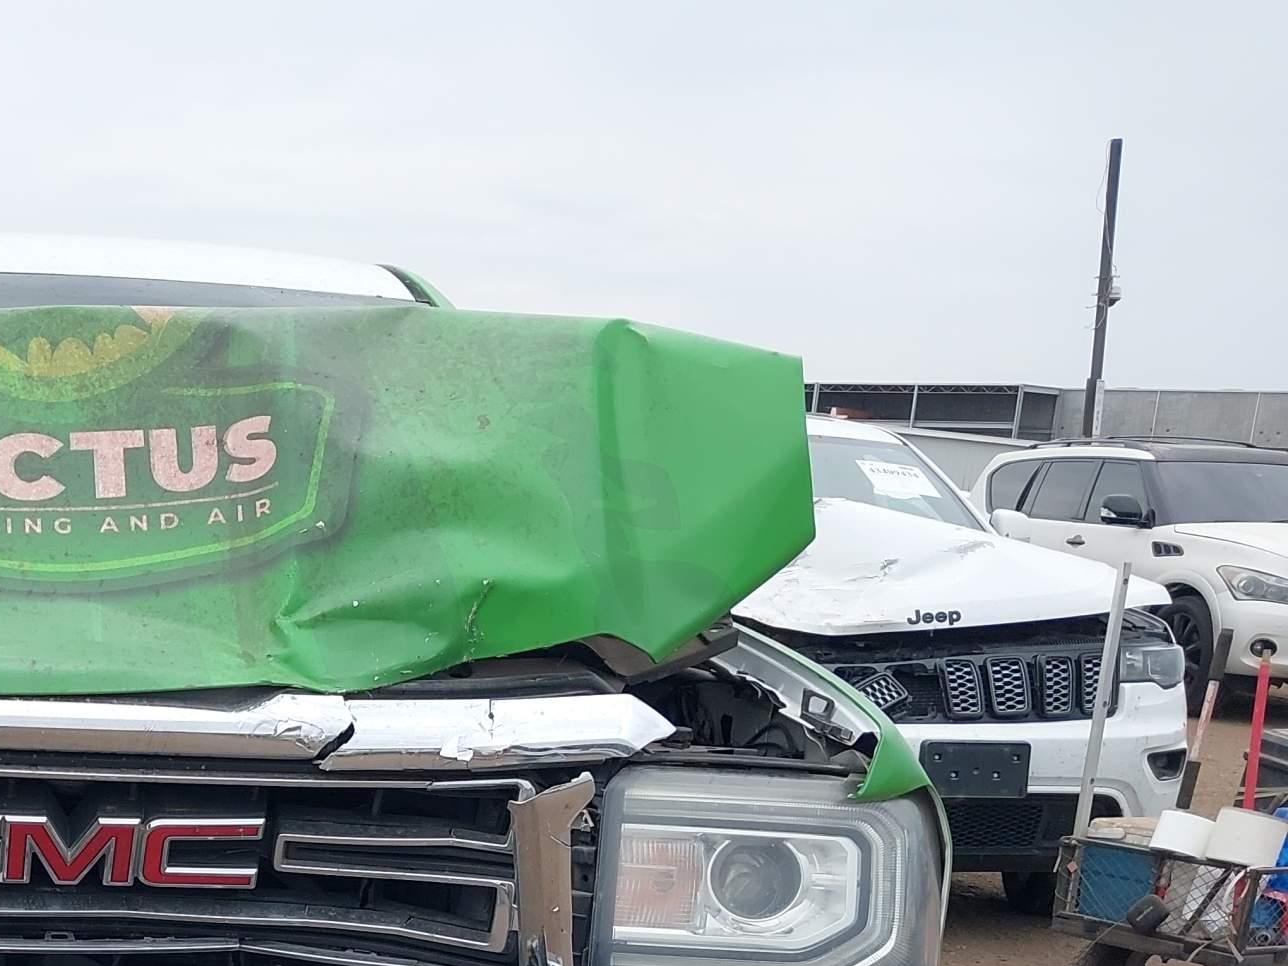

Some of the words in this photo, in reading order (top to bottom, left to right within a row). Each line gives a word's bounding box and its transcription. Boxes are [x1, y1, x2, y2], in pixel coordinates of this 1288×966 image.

[100, 512, 180, 533] AND
[208, 498, 272, 526] AIR
[906, 609, 962, 626] Jeep
